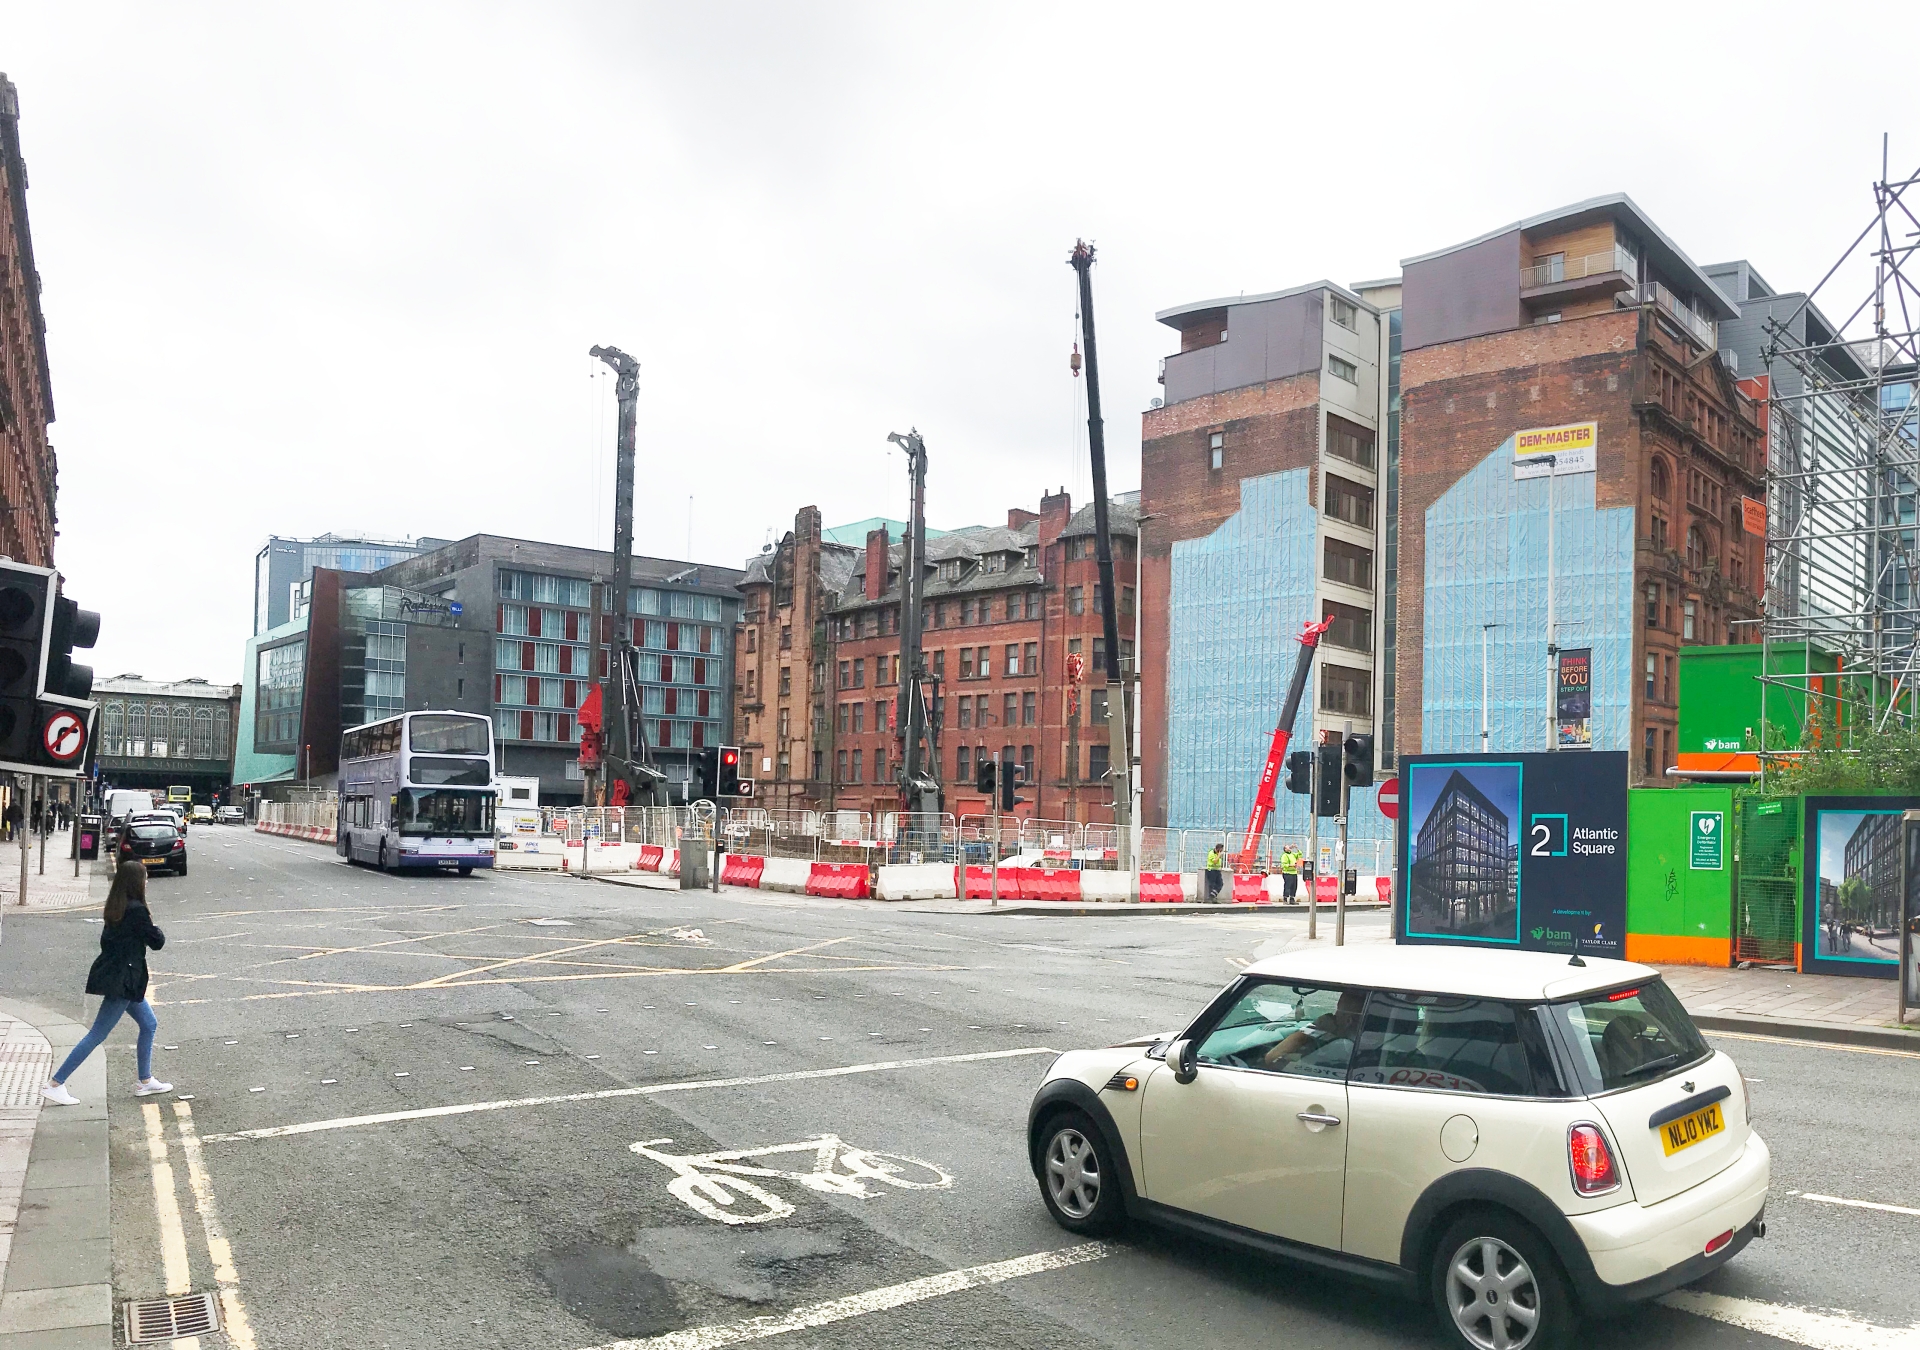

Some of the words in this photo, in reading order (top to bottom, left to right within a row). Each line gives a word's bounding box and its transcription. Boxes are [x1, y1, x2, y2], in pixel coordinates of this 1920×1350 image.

[1519, 428, 1590, 448] DEM-MASTER
[1561, 657, 1588, 666] THINK
[1561, 665, 1588, 674] BEFORE
[1561, 673, 1588, 685] YOU
[1718, 739, 1740, 750] bam
[153, 760, 195, 770] STATION
[1572, 827, 1619, 840] Atlantic
[1530, 824, 1551, 857] 2
[1572, 841, 1616, 857] Square
[1546, 926, 1572, 940] bam
[1667, 1117, 1698, 1149] NL10
[1696, 1108, 1719, 1136] YMZ
